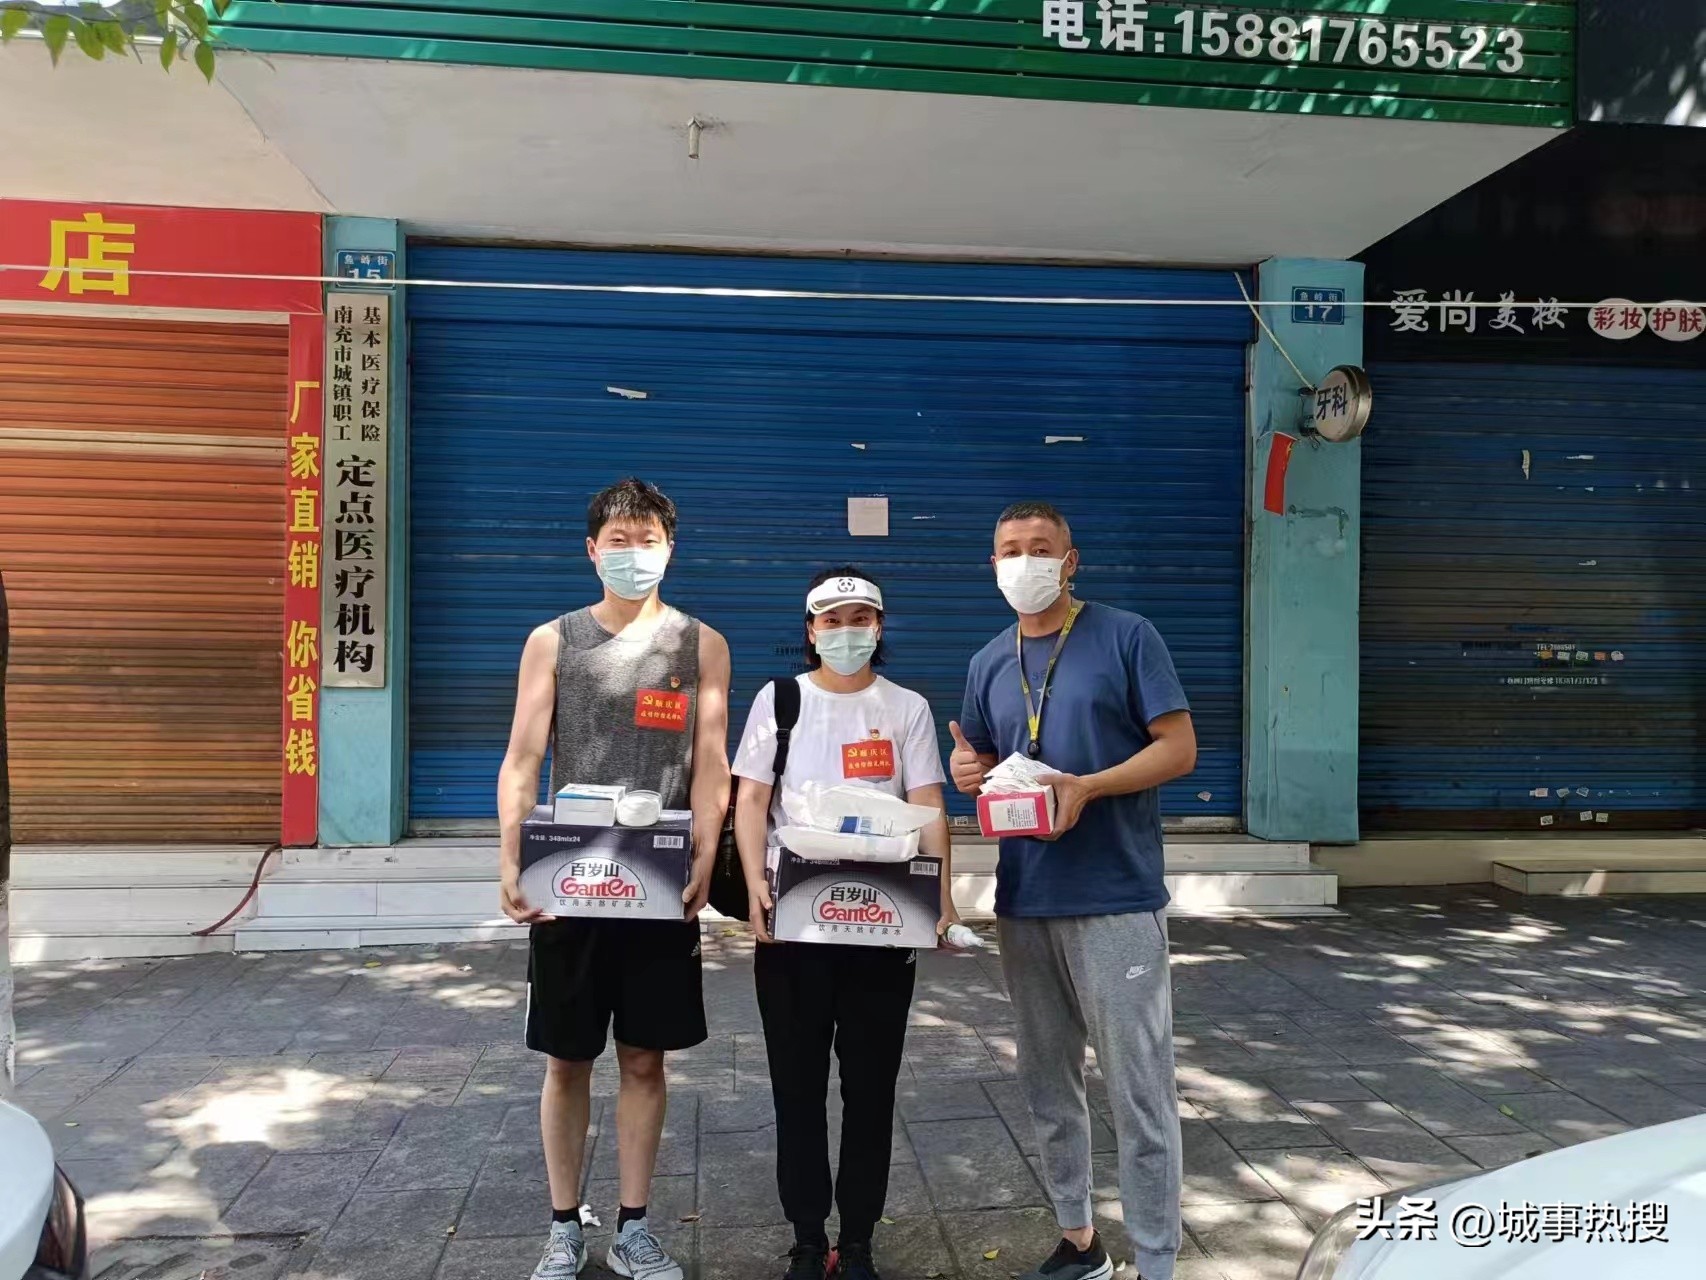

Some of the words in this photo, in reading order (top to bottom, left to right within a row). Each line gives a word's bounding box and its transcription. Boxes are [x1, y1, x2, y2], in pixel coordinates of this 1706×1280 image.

[39, 212, 135, 296] 店
[1304, 303, 1333, 321] 17
[1389, 288, 1569, 334] 爱尚美妆
[1593, 305, 1643, 331] 彩妆
[1652, 306, 1703, 333] 护肤
[332, 305, 354, 442] 南充市城镇职工
[360, 306, 381, 442] 基本医疗保险
[1315, 382, 1349, 422] 牙科
[288, 380, 321, 589] 厂家直销
[334, 454, 376, 673] 定点医疗机构
[285, 620, 319, 777] 你省钱
[571, 862, 619, 878] 百岁山
[559, 899, 645, 908] 饮用天然矿泉水
[560, 877, 637, 898] Ganten
[830, 886, 878, 903] 百岁山
[820, 901, 893, 924] Ganten
[818, 924, 902, 936] 饮用天然矿泉水
